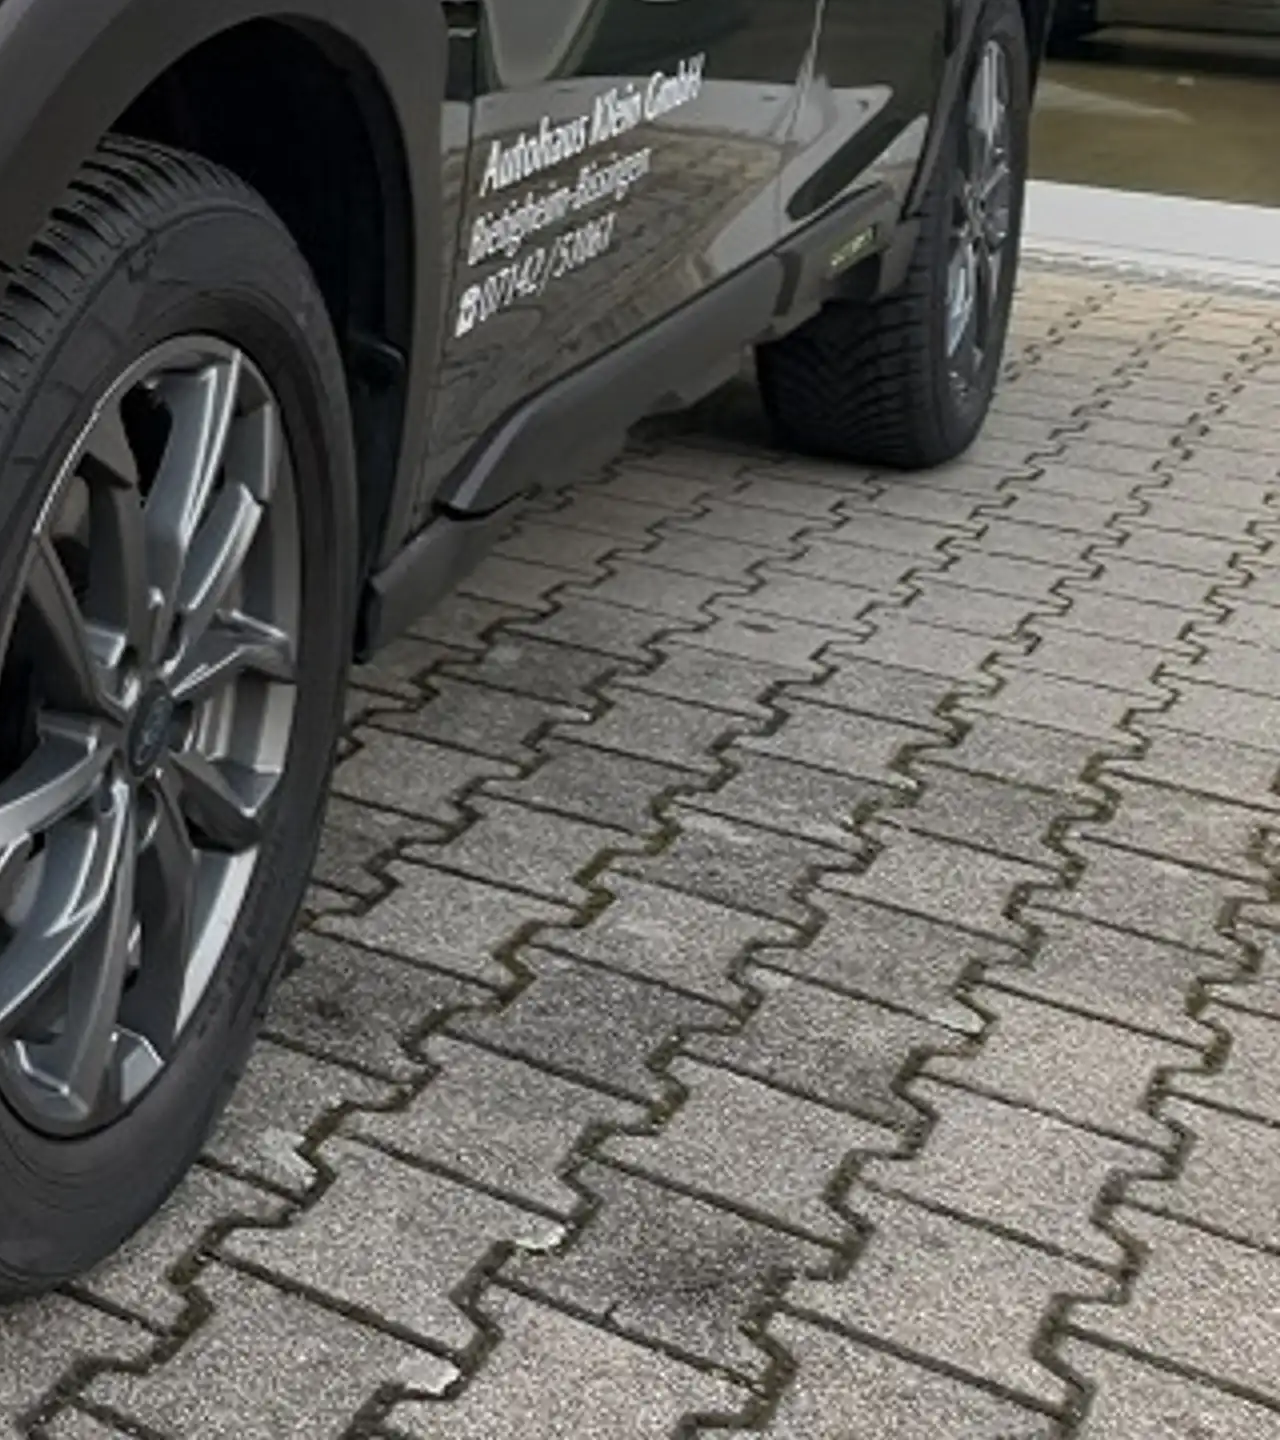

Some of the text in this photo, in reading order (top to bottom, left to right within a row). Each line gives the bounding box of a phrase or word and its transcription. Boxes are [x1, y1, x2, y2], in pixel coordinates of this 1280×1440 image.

[479, 51, 706, 198] Autohaus Klein GmbH
